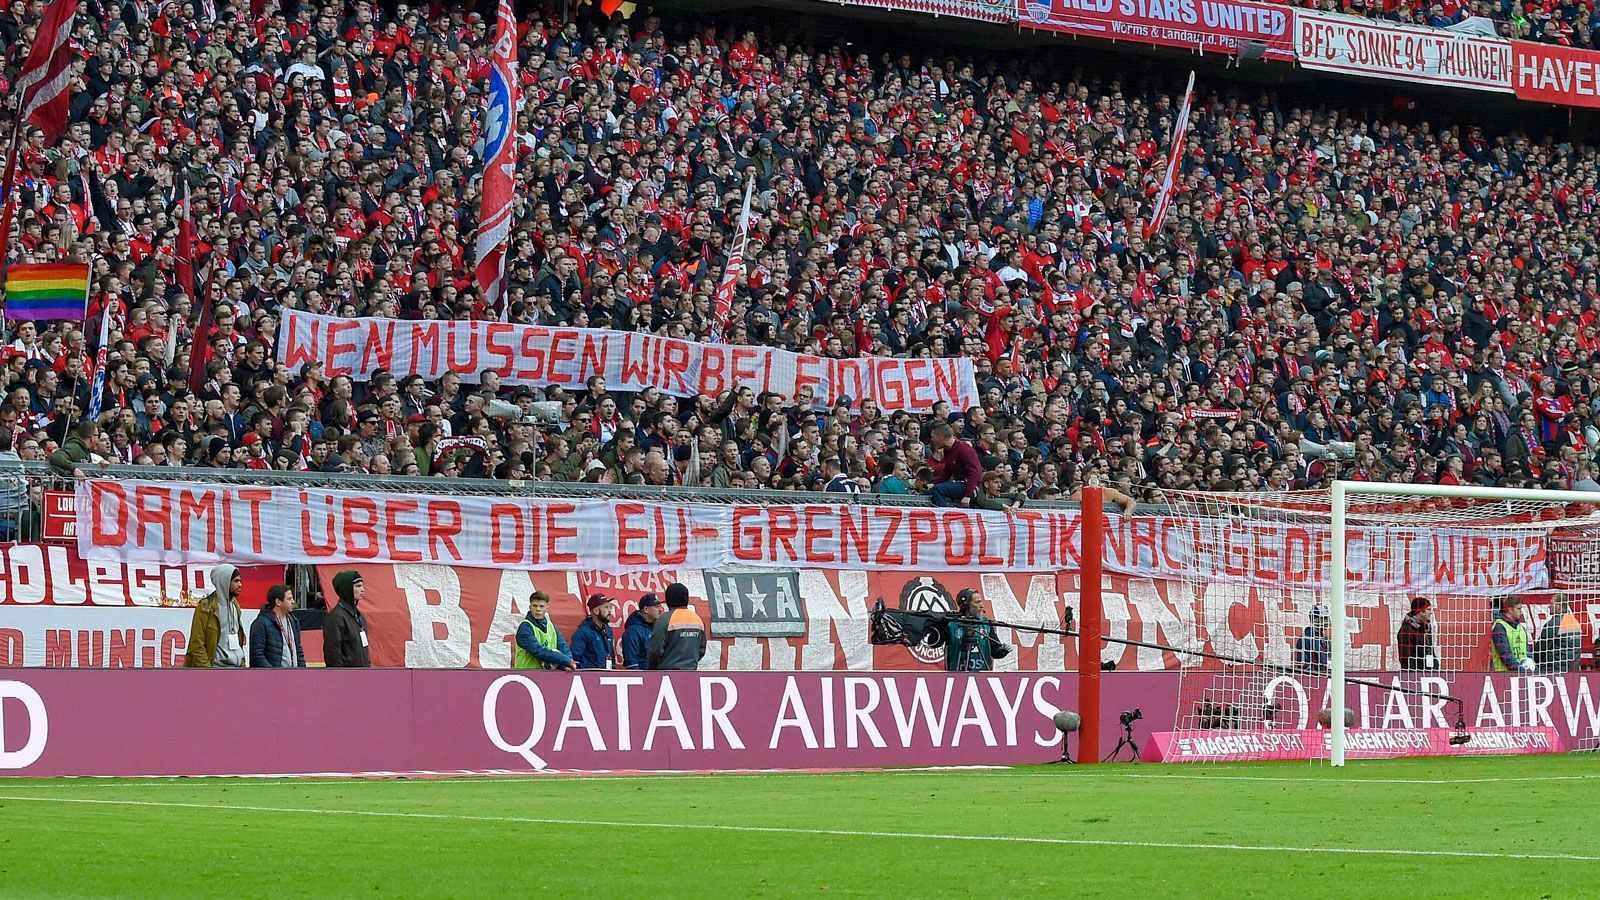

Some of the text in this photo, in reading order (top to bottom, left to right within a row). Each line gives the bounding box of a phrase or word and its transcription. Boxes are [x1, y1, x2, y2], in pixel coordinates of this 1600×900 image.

[1112, 20, 1149, 36] Worms
[1150, 26, 1159, 38] &
[1162, 28, 1199, 43] Landau
[1119, 0, 1197, 24] STARS
[1201, 1, 1286, 36] UNITED
[1302, 22, 1510, 82] BFC "SONNE 94" THÜNGEN
[285, 314, 394, 378] WEN
[408, 319, 609, 384] MÜSSEN
[621, 331, 690, 393] WIR
[57, 497, 77, 512] LOV
[91, 481, 1547, 587] DAMIT ÜBER DIE EU-GRENZPOLITIK NACHGEDACHT WIRD?
[482, 675, 1063, 770] QATAR AIRWAYS
